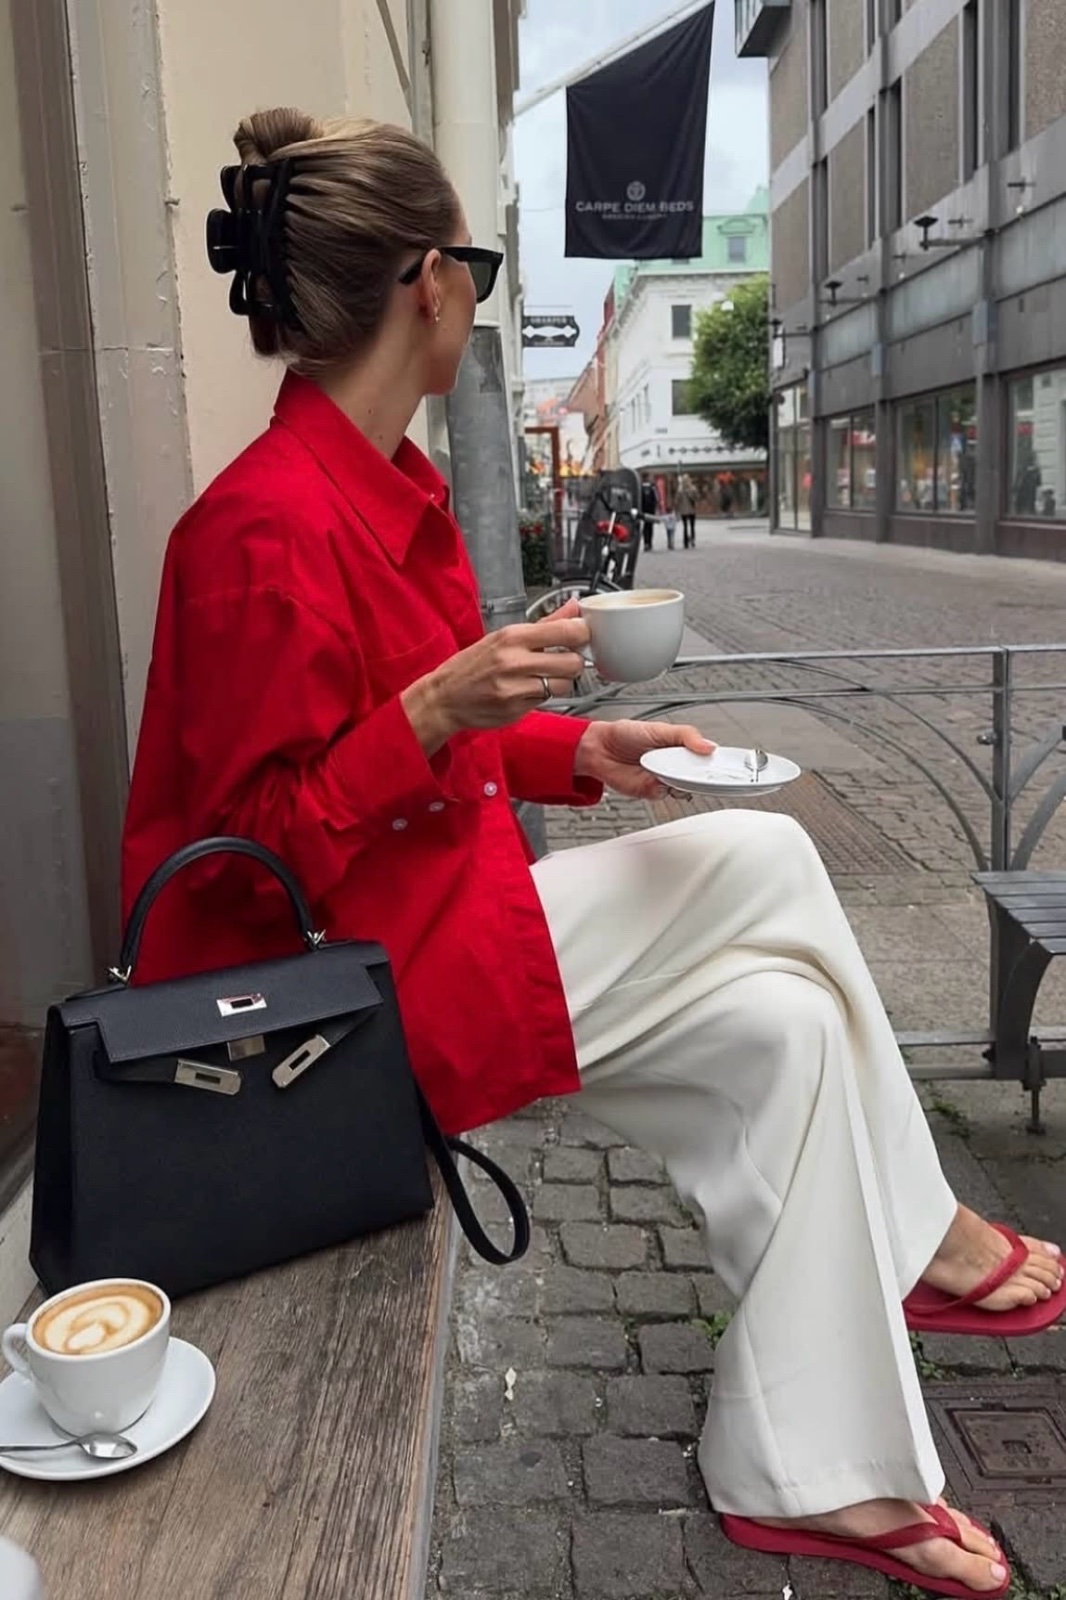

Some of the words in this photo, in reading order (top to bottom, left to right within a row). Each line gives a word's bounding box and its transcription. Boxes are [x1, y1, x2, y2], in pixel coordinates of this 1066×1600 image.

[575, 201, 620, 213] CARPE
[624, 201, 656, 213] DIEM
[659, 201, 694, 213] BEDS
